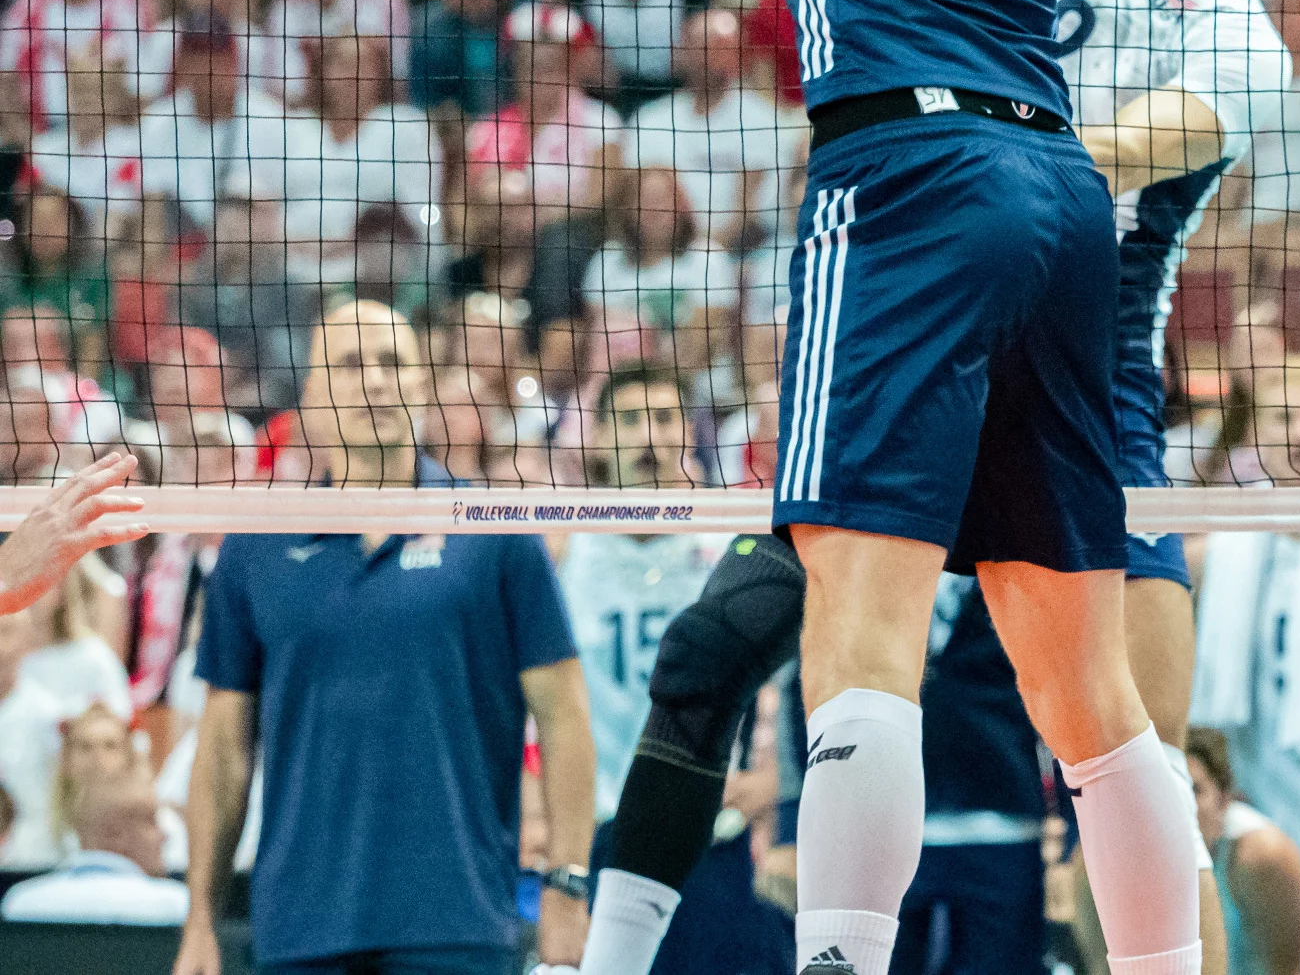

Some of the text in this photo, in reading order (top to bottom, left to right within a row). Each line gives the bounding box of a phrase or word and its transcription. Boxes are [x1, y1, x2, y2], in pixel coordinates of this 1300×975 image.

[466, 506, 693, 521] VOLLEYBALL WORLD CHAMPIONSHIP 2022
